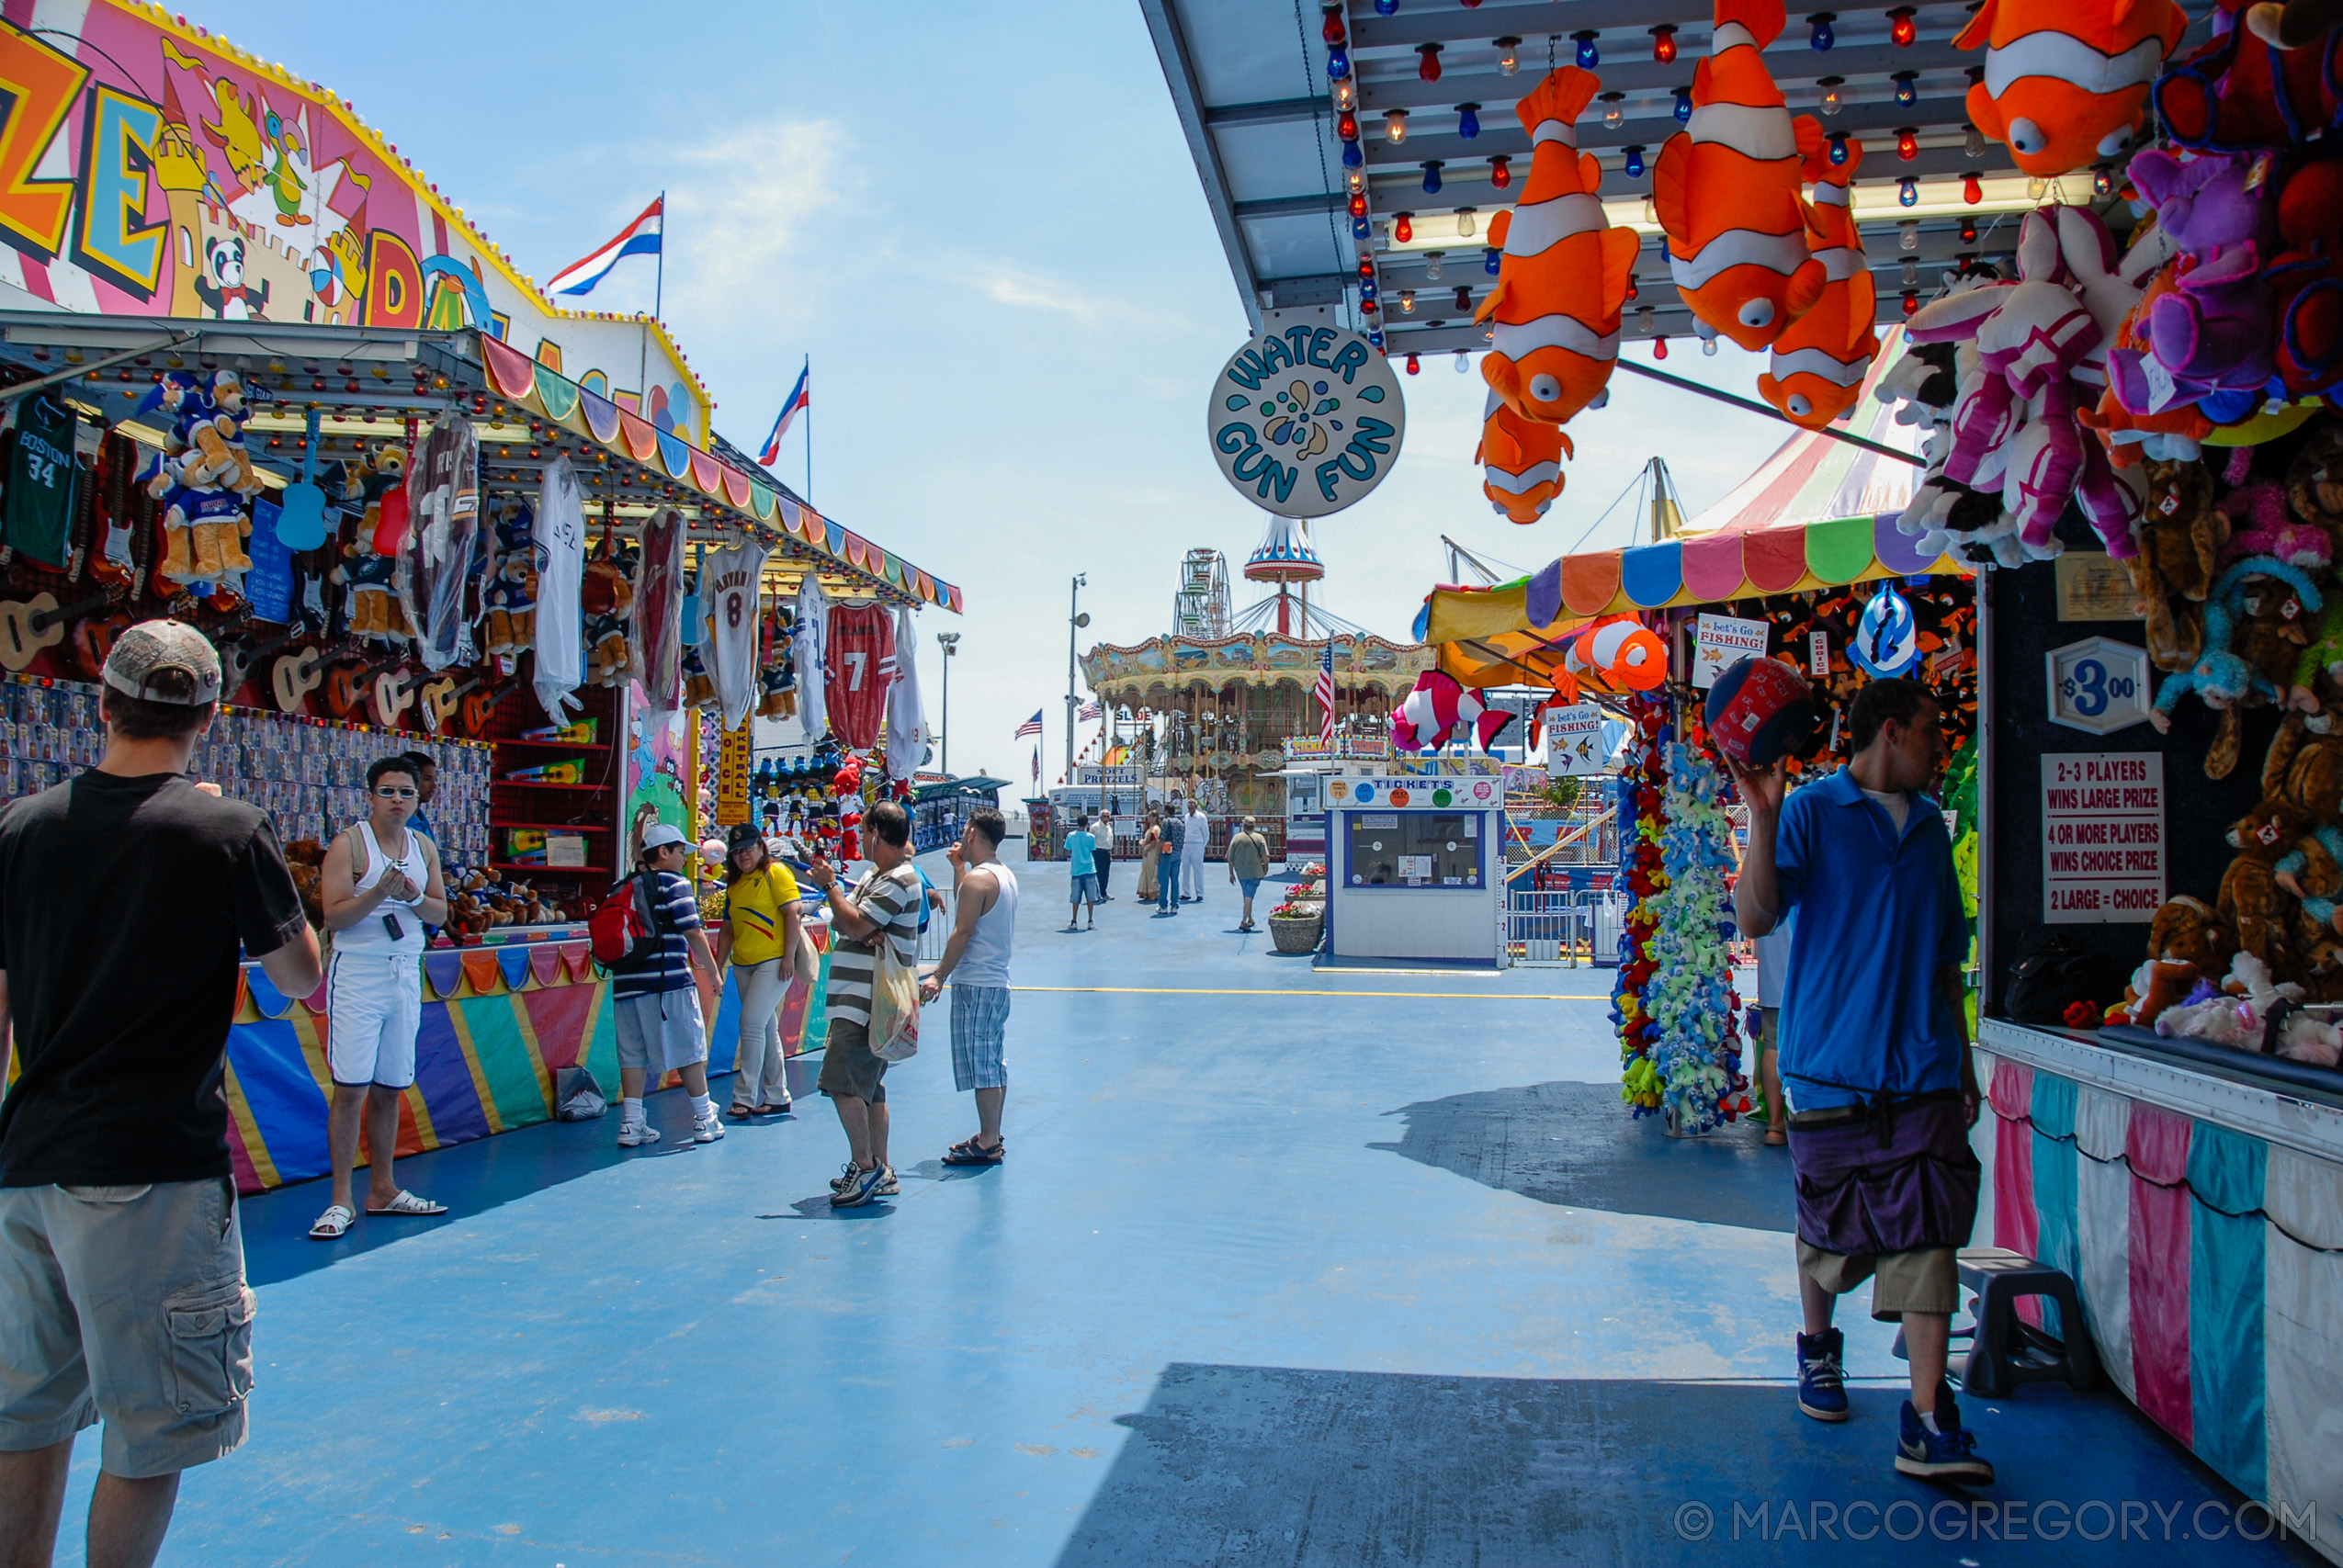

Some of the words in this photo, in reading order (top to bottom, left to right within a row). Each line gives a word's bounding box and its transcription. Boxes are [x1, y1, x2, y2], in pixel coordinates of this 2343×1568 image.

[1227, 325, 1369, 391] WATER
[19, 430, 70, 468] BOSTON
[1216, 422, 1298, 502] GUN
[1315, 416, 1396, 502] FUN
[28, 453, 55, 489] 34
[727, 592, 742, 629] 8
[1714, 622, 1737, 634] Let's
[1740, 625, 1753, 636] Go
[1700, 631, 1764, 649] FISHING!
[1815, 638, 1826, 673] CHOICE
[843, 651, 867, 692] 7
[1116, 711, 1151, 720] SLDE
[1557, 712, 1577, 722] Let's
[1579, 711, 1590, 719] Go
[1548, 720, 1599, 734] FISHING!
[1351, 739, 1386, 755] TICKETS
[1084, 773, 1138, 784] PRETZELS
[2057, 761, 2081, 782] 2-3
[2087, 761, 2146, 782] PLAYERS
[1373, 779, 1454, 789] TICKETS
[2047, 788, 2078, 809] WINS
[2081, 788, 2121, 808] LARGE
[2123, 787, 2158, 808] PRIZE
[2048, 825, 2054, 844] 4
[2057, 824, 2073, 844] OR
[2077, 824, 2107, 844] MORE
[2111, 823, 2159, 843] PLAYERS
[2050, 851, 2078, 872] WINS
[2081, 851, 2122, 872] CHOICE
[2125, 850, 2158, 871] PRIZE
[1501, 900, 1505, 908] 3
[2051, 890, 2058, 910] 2
[2061, 889, 2100, 910] LARGE
[2113, 888, 2158, 909] CHOICE
[1501, 922, 1506, 931] 2
